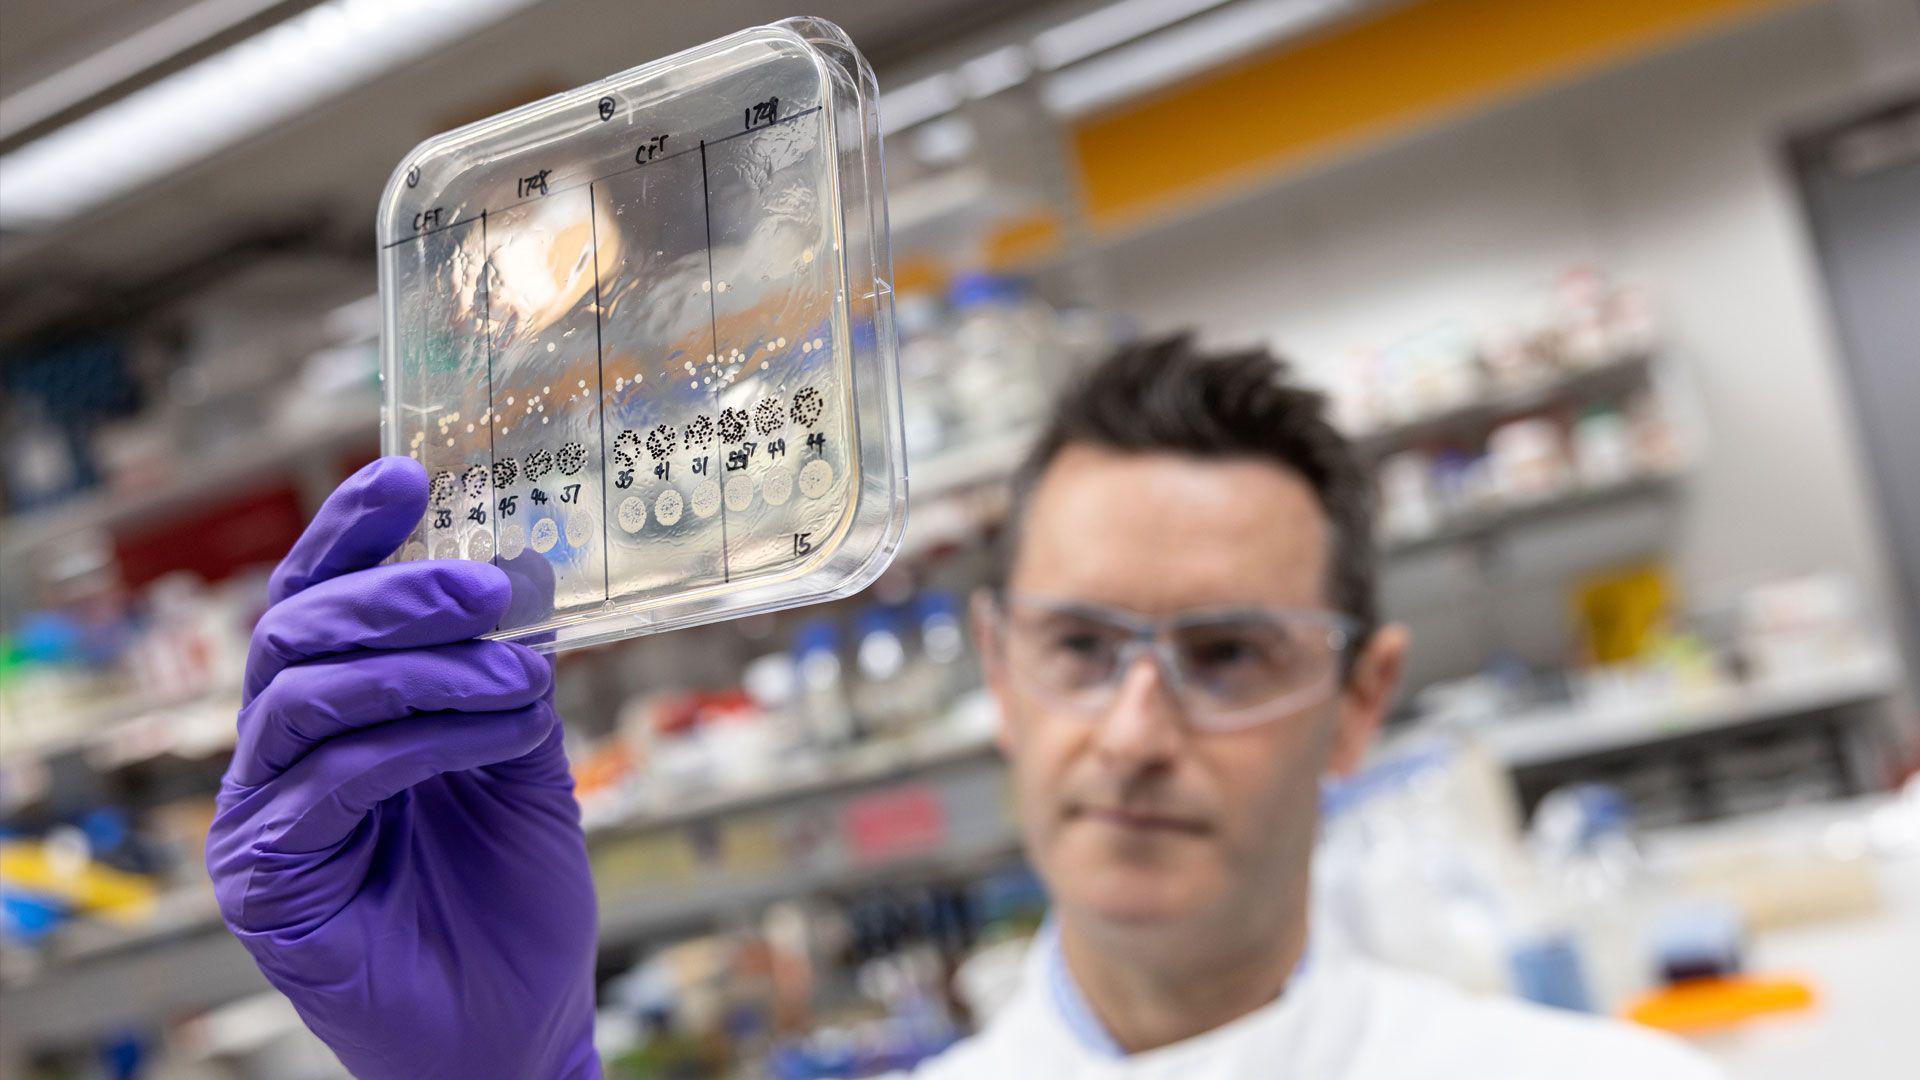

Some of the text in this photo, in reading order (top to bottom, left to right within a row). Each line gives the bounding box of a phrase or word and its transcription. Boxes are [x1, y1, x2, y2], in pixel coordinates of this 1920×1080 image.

[413, 207, 444, 231] CFT
[615, 469, 634, 489] 35
[654, 461, 669, 480] 41
[692, 456, 708, 476] 31
[768, 438, 785, 460] 49
[807, 433, 825, 454] 44
[434, 510, 452, 529] 33
[468, 503, 486, 524] 26
[560, 484, 582, 504] 37
[793, 532, 812, 556] 15
